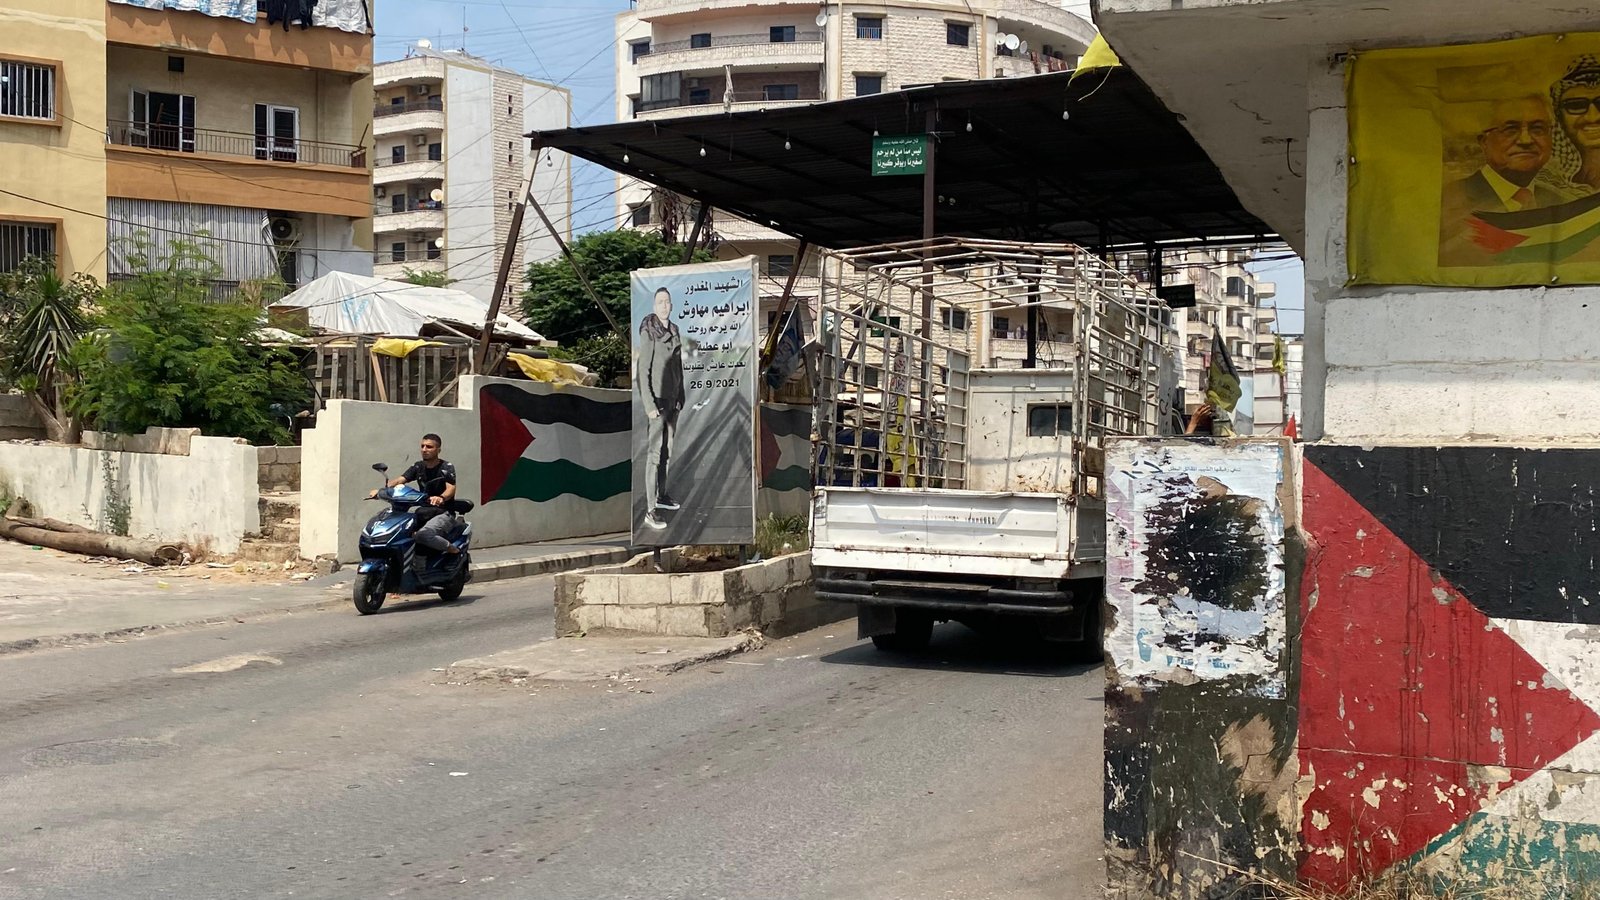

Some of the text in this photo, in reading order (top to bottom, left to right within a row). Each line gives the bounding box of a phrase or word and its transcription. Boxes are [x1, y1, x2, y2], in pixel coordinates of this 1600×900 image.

[890, 148, 895, 156] لم
[911, 146, 922, 156] ليس
[876, 157, 923, 169] صغيرنا ويوقر كبيرنا
[685, 276, 743, 295] الشهيد المغدور
[678, 300, 709, 320] مهاوش
[687, 321, 741, 336] الله يرحم روحك
[697, 338, 733, 354] أبو عطية
[683, 361, 705, 373] بقلوبنا
[706, 359, 726, 372] عايش
